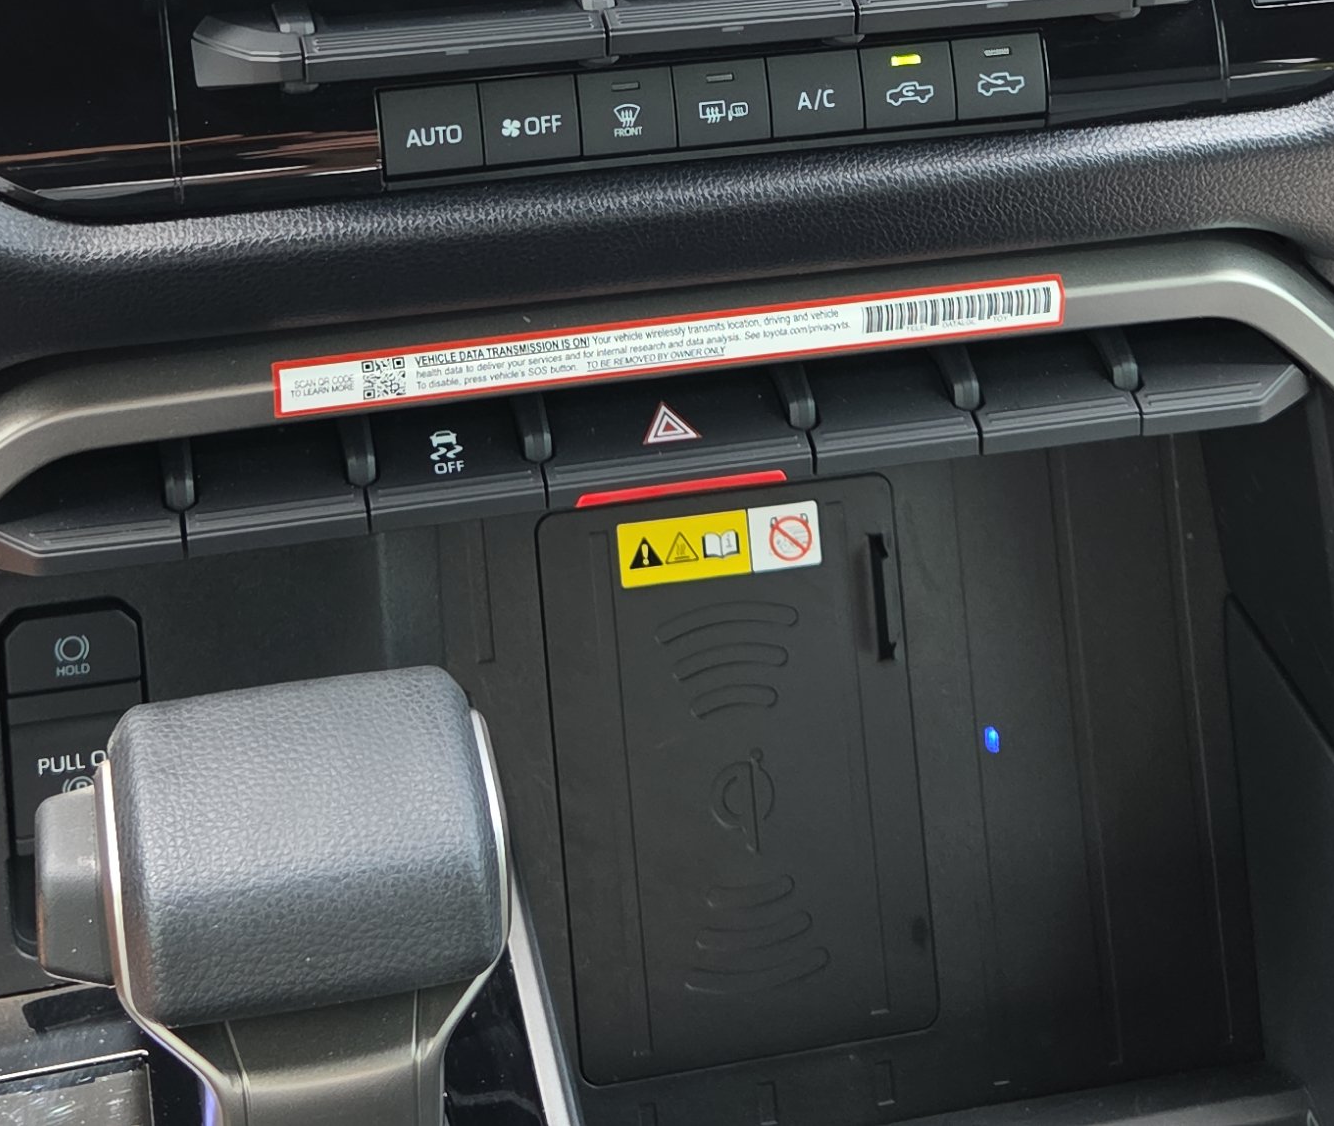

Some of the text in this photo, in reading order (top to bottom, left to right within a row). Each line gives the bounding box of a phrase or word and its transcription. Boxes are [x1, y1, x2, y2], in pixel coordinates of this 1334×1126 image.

[797, 88, 835, 111] A/C
[405, 124, 463, 148] AUTO
[524, 114, 563, 136] OFF
[613, 125, 643, 138] FRONT
[415, 351, 457, 367] VEHICLE
[459, 348, 485, 363] DATA
[486, 339, 560, 359] TRANSMISSION
[561, 338, 571, 350] IS
[592, 334, 611, 346] Your
[614, 331, 643, 343] vehicle
[645, 325, 686, 340] wirelessly
[687, 320, 726, 334] transmits
[763, 314, 791, 327] driving
[793, 312, 809, 323] and
[811, 308, 839, 321] vehicle
[416, 365, 442, 379] health
[444, 363, 463, 376] data
[477, 357, 505, 372] deliver
[507, 357, 526, 370] your
[528, 352, 563, 366] services
[565, 350, 580, 362] and
[629, 340, 666, 354] research
[668, 338, 684, 349] and
[685, 336, 704, 348] data
[416, 379, 427, 390] To
[464, 372, 488, 386] press
[528, 365, 548, 377] SOS
[586, 359, 599, 370] TO
[434, 460, 465, 474] OFF
[56, 662, 91, 677] HOLD
[37, 749, 108, 776] PULL O
